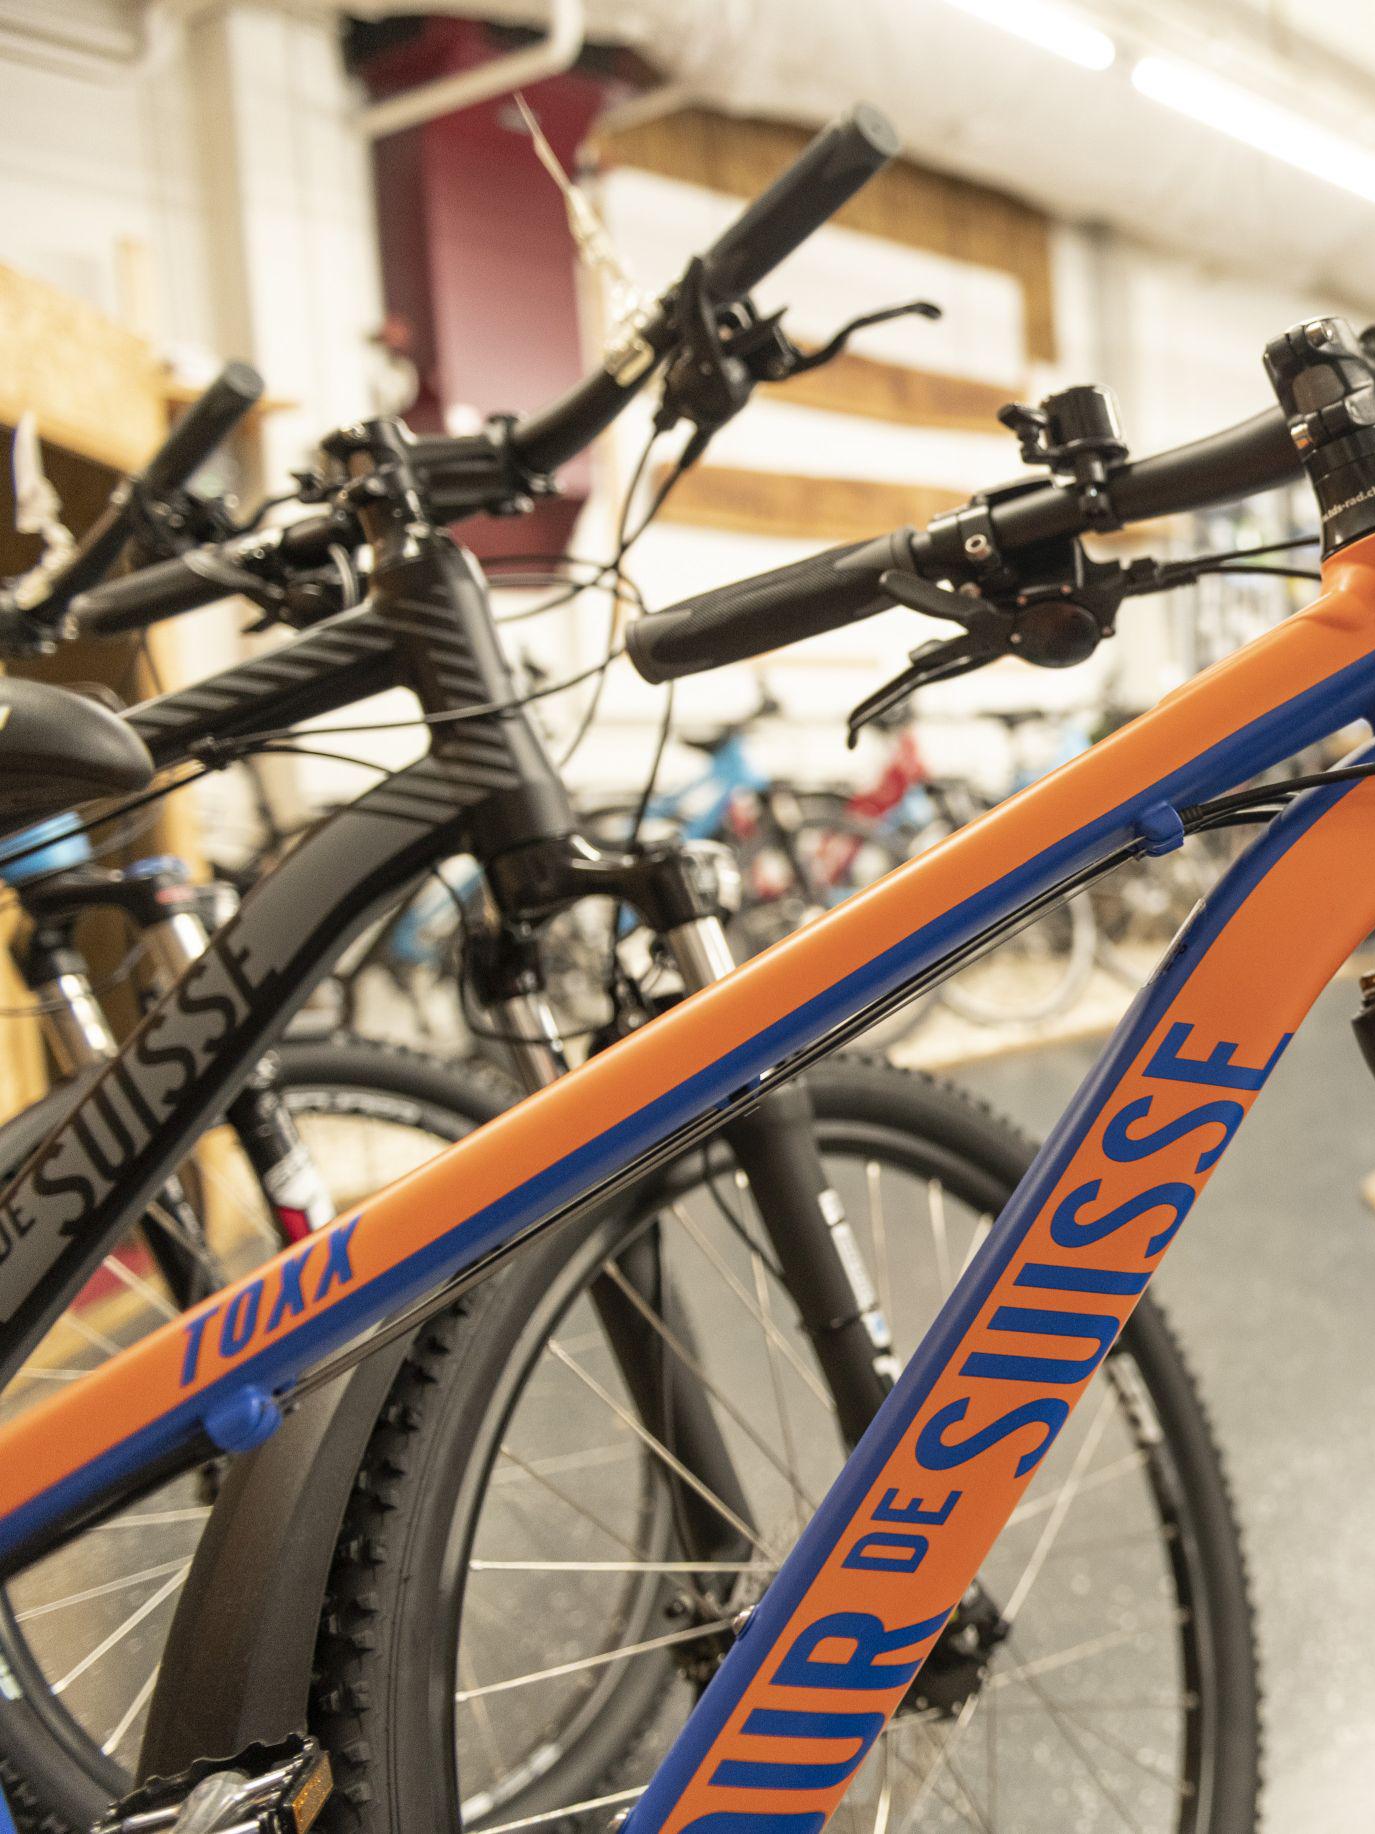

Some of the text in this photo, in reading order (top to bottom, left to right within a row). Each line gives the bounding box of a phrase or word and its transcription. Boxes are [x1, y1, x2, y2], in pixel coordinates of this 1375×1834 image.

[30, 938, 285, 1238] SUISSE
[179, 1214, 363, 1387] TOXX
[675, 1021, 1295, 1834] UR DE SUISSE
